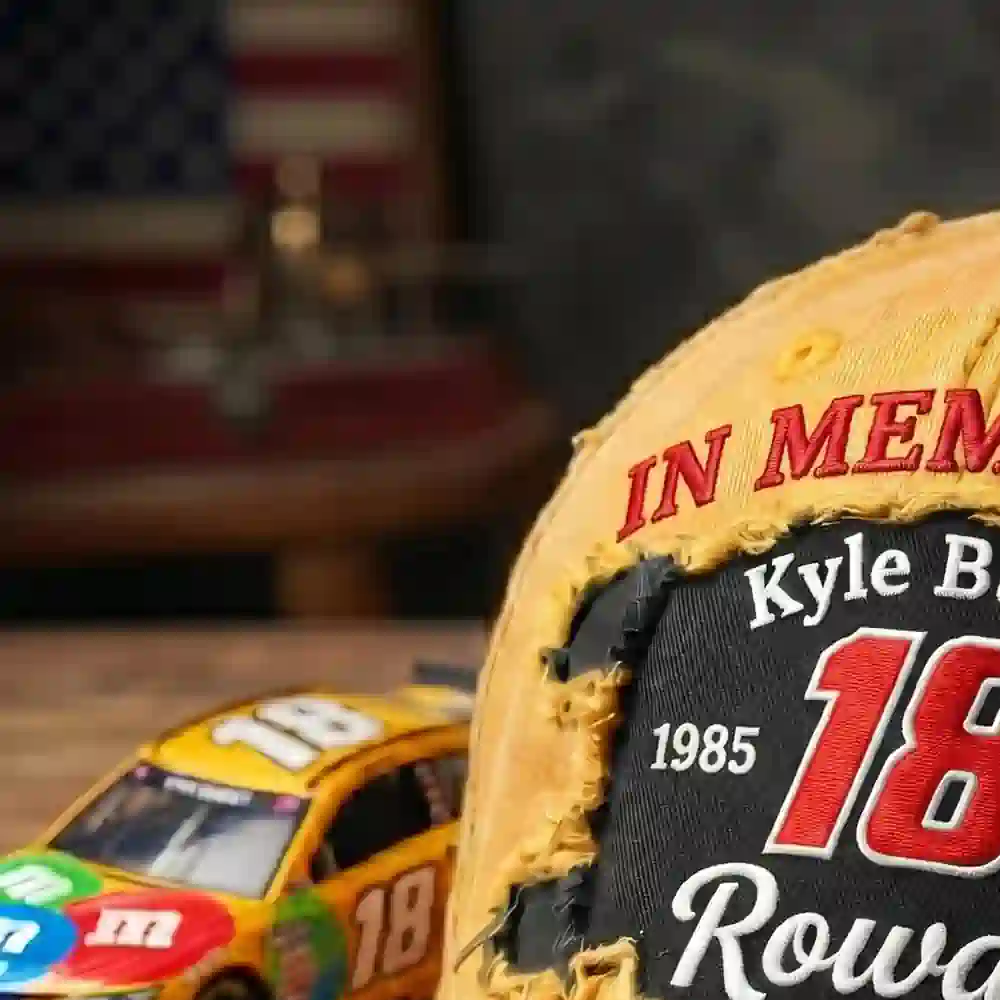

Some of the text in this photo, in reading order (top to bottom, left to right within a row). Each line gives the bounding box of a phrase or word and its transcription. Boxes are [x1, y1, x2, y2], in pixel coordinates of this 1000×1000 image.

[616, 424, 732, 543] IN
[744, 532, 911, 630] Kyle
[212, 697, 383, 770] 18
[650, 722, 760, 775] 1985
[84, 909, 183, 949] m
[352, 865, 436, 990] 18
